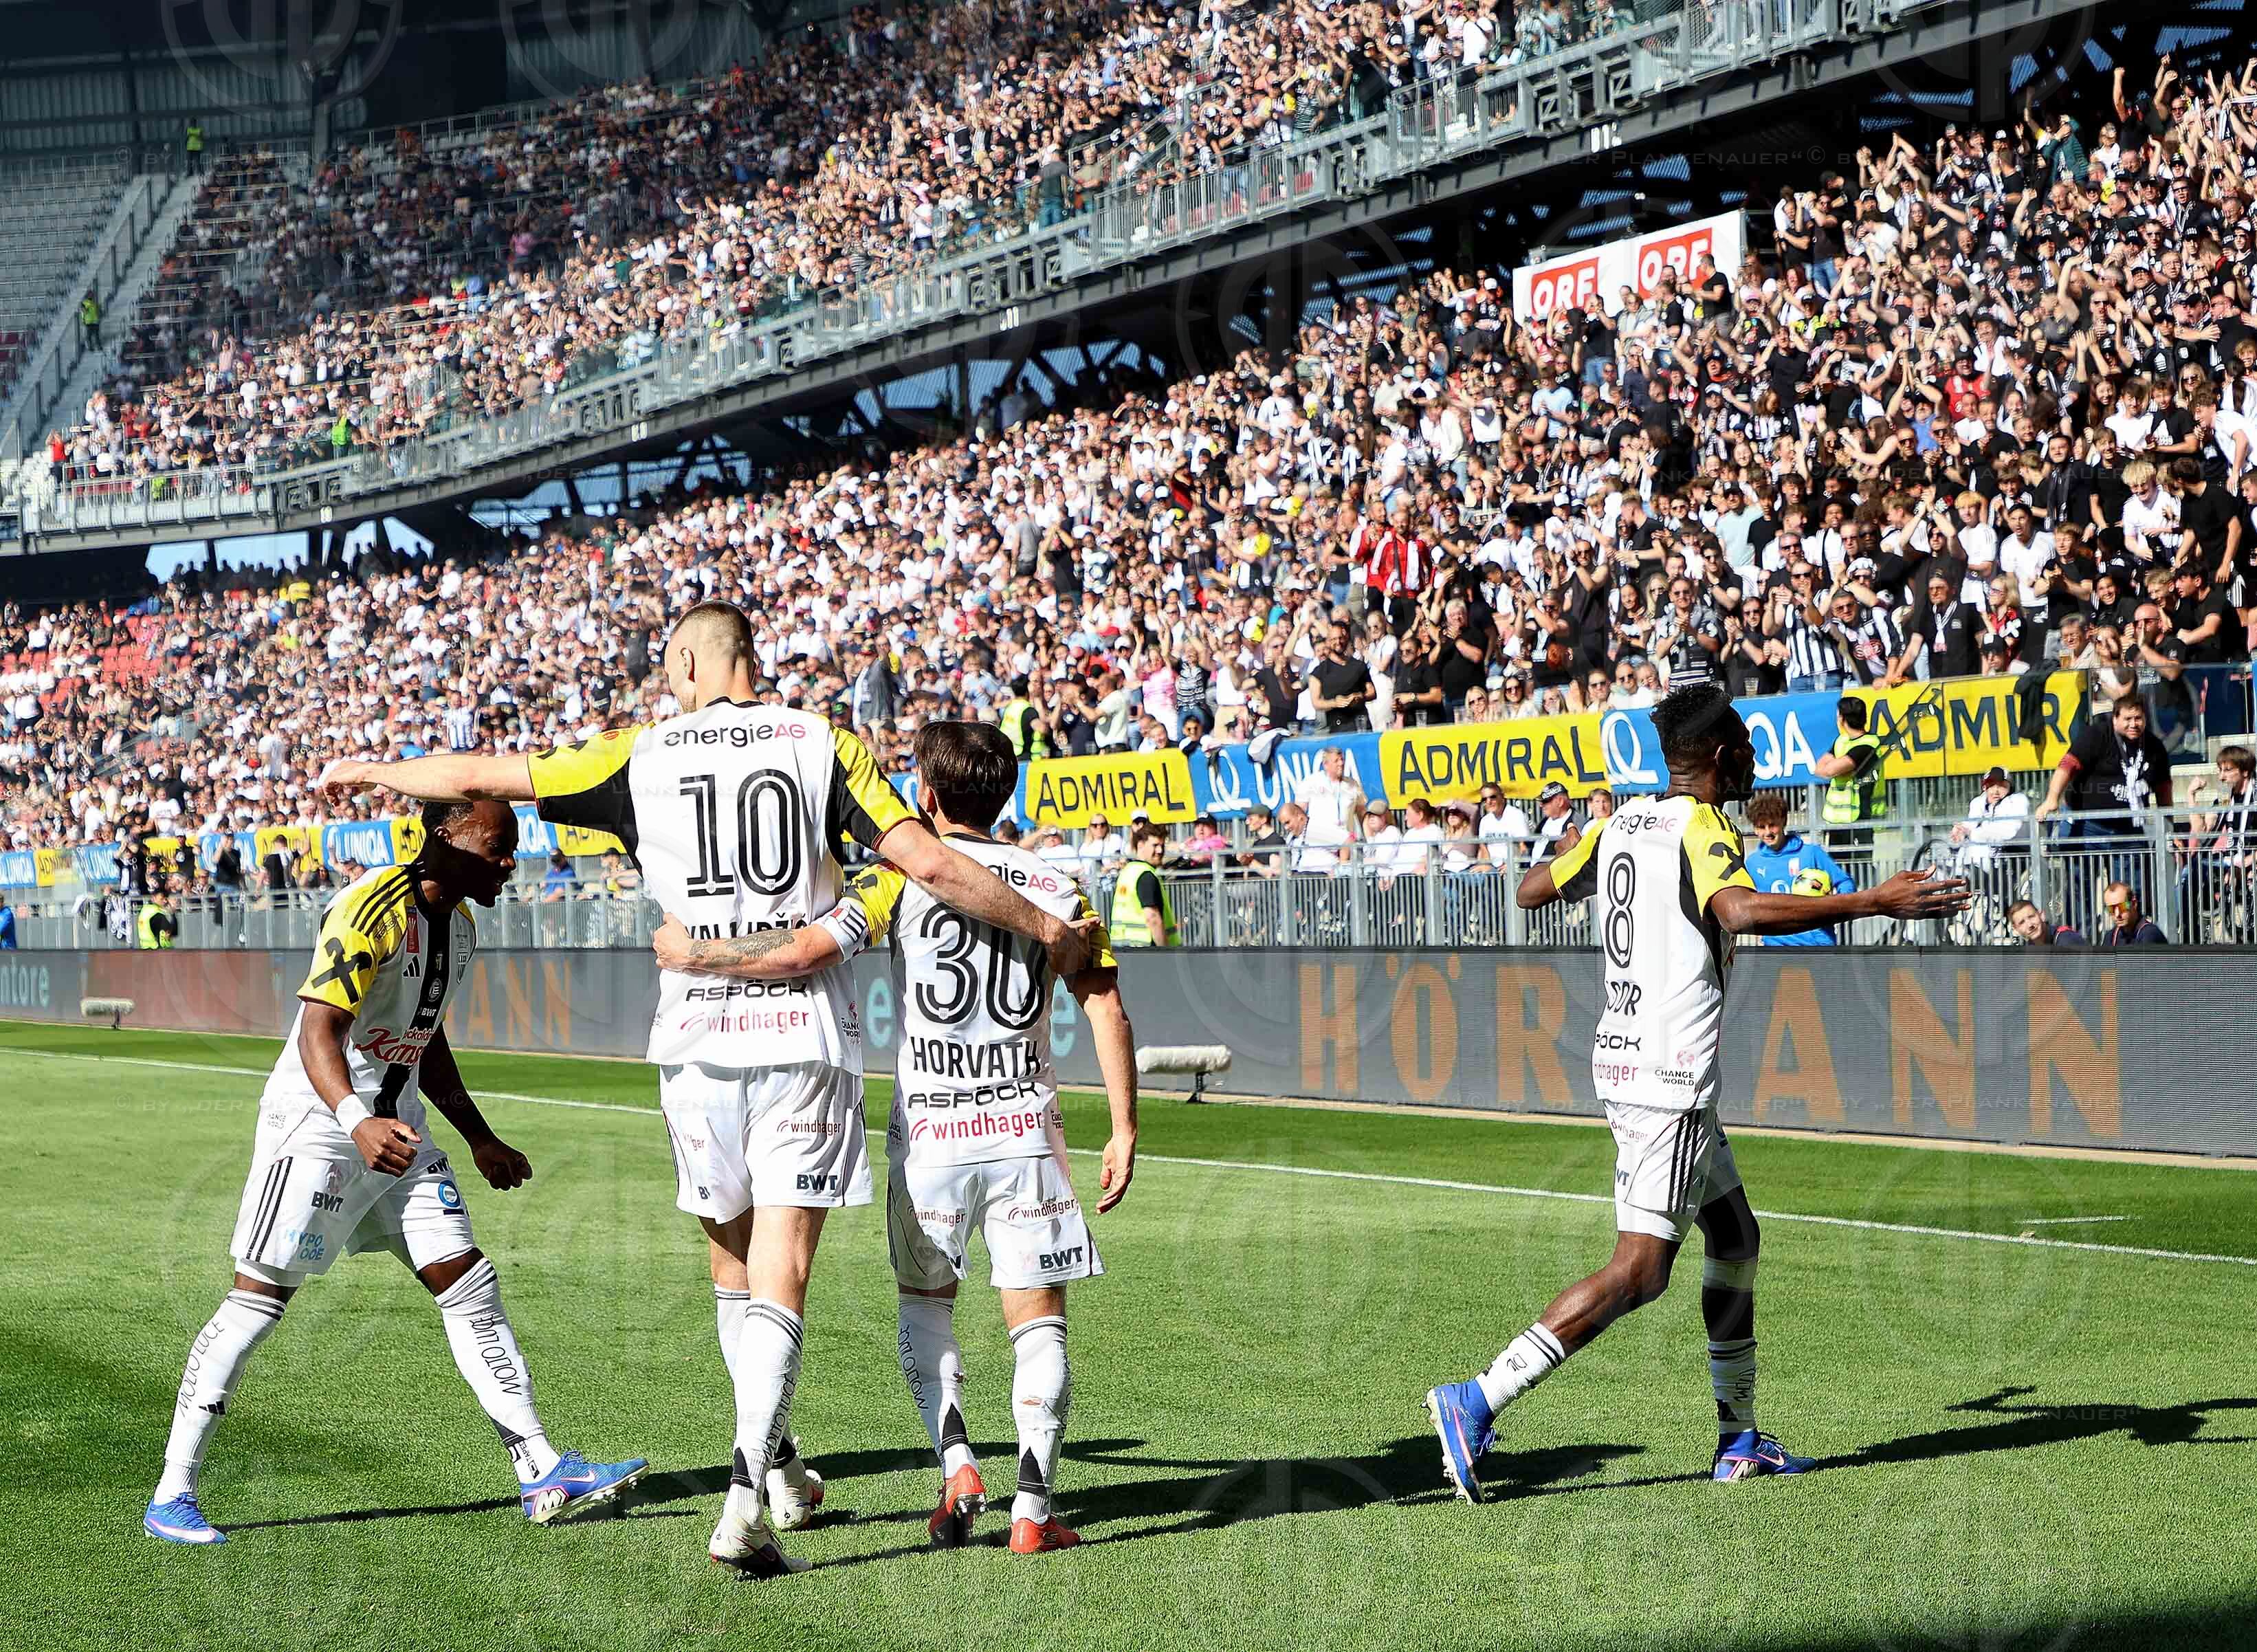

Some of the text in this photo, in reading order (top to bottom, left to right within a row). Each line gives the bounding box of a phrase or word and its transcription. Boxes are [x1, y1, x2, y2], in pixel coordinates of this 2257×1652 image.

[1640, 239, 1706, 290] ORF
[1533, 266, 1596, 320] ORF
[664, 723, 806, 747] energieAG
[1870, 690, 2088, 762] ADMIR
[1399, 726, 1605, 795] ADMIRAL
[1035, 762, 1186, 819] ADMIRAL
[680, 769, 803, 896] 10
[1606, 852, 1636, 968] 8
[915, 901, 1047, 1031] 30
[685, 979, 809, 1002] ASPÖCK
[421, 1007, 437, 1017] BWT
[707, 1009, 809, 1033] windhager
[910, 1036, 1042, 1079] HORVATH
[1655, 1068, 1695, 1079] CHANGE
[1662, 1078, 1695, 1086] WORLD
[907, 1081, 1039, 1109] ASPÖCK
[791, 1119, 841, 1136] windhager
[932, 1110, 1042, 1140] windhager
[797, 1174, 838, 1191] BWT
[311, 1191, 344, 1213] BWT
[1021, 1198, 1075, 1219] windhager
[914, 1208, 965, 1227] windhager
[1039, 1246, 1083, 1270] BWT
[179, 1321, 225, 1418] MOLTO LUCE
[481, 1346, 522, 1396] MOLTO
